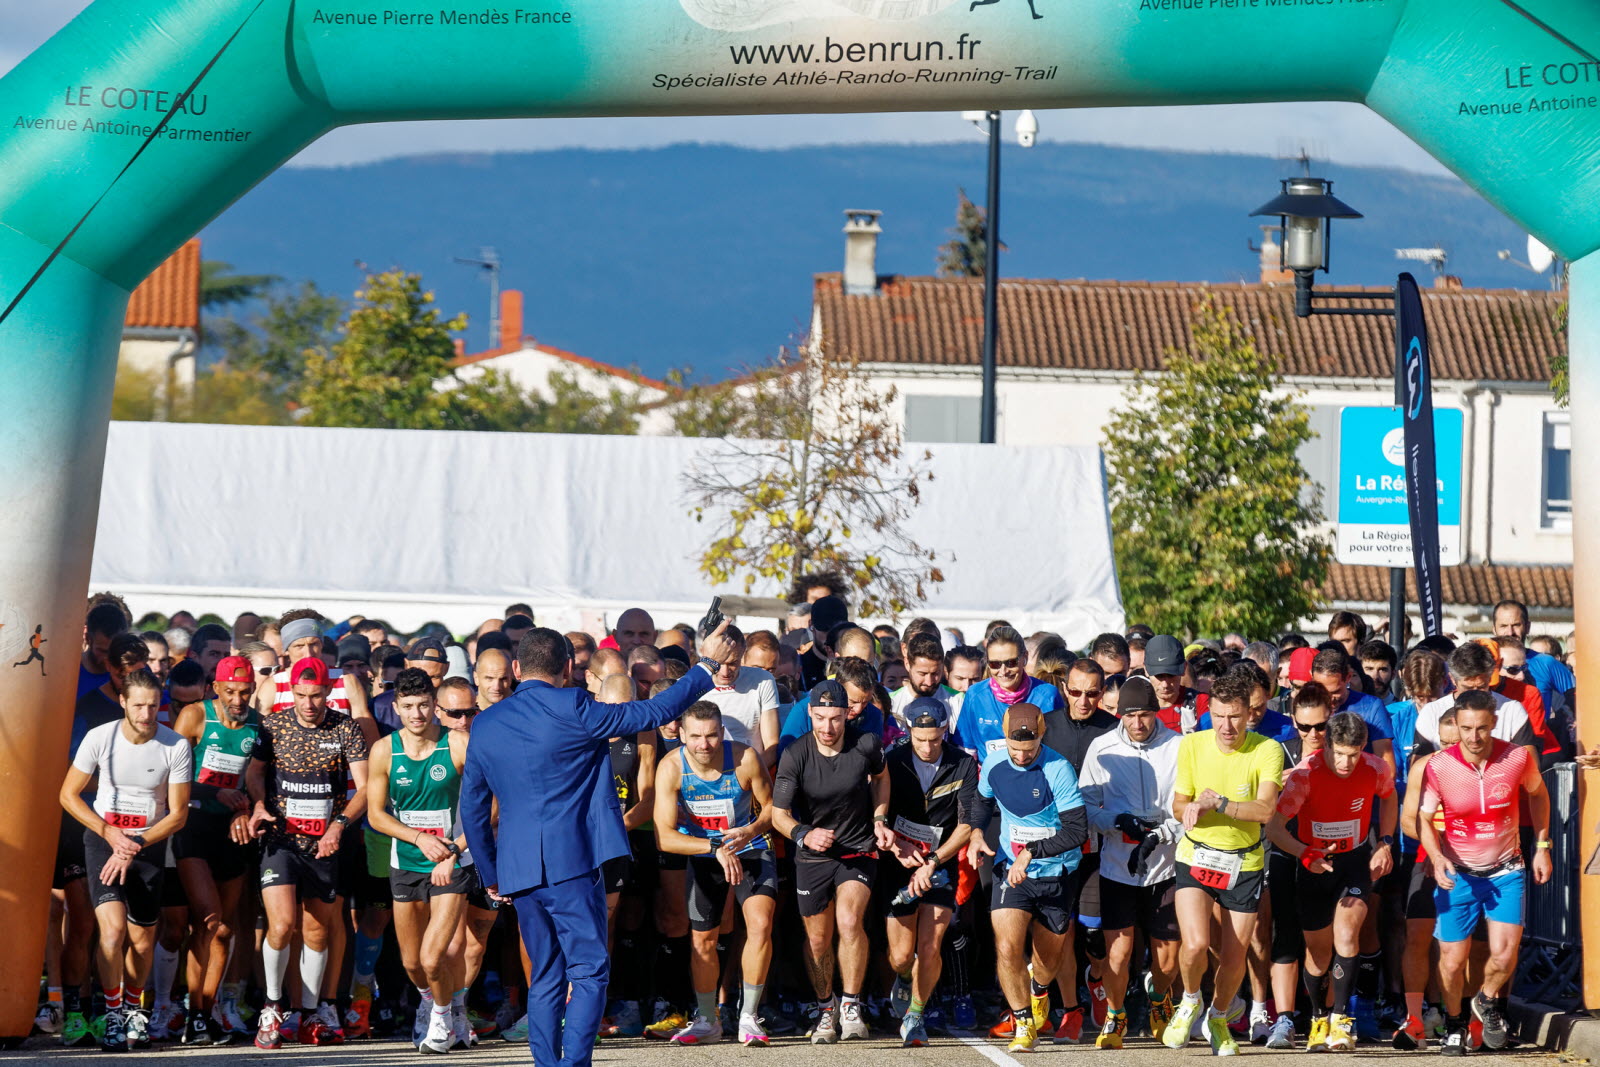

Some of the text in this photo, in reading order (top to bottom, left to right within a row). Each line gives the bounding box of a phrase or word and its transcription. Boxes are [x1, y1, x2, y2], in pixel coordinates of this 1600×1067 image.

[312, 8, 572, 25] Avenue Pierre Mendès France
[730, 33, 982, 65] www.benrun.fr
[652, 65, 1058, 89] Spécialiste Athlé-Rando-Running-Trail
[1505, 65, 1533, 89] LE
[65, 86, 207, 116] LE COTEAU
[1458, 94, 1598, 116] Avenue Antoine
[13, 115, 252, 142] Avenue Antoine Parmentier
[1355, 474, 1377, 491] La
[1362, 530, 1374, 540] La
[1349, 544, 1373, 553] pour
[1376, 544, 1403, 552] votre
[207, 771, 234, 786] 213
[281, 780, 332, 794] FINISHER
[112, 814, 141, 827] 285
[1198, 869, 1225, 885] 377
